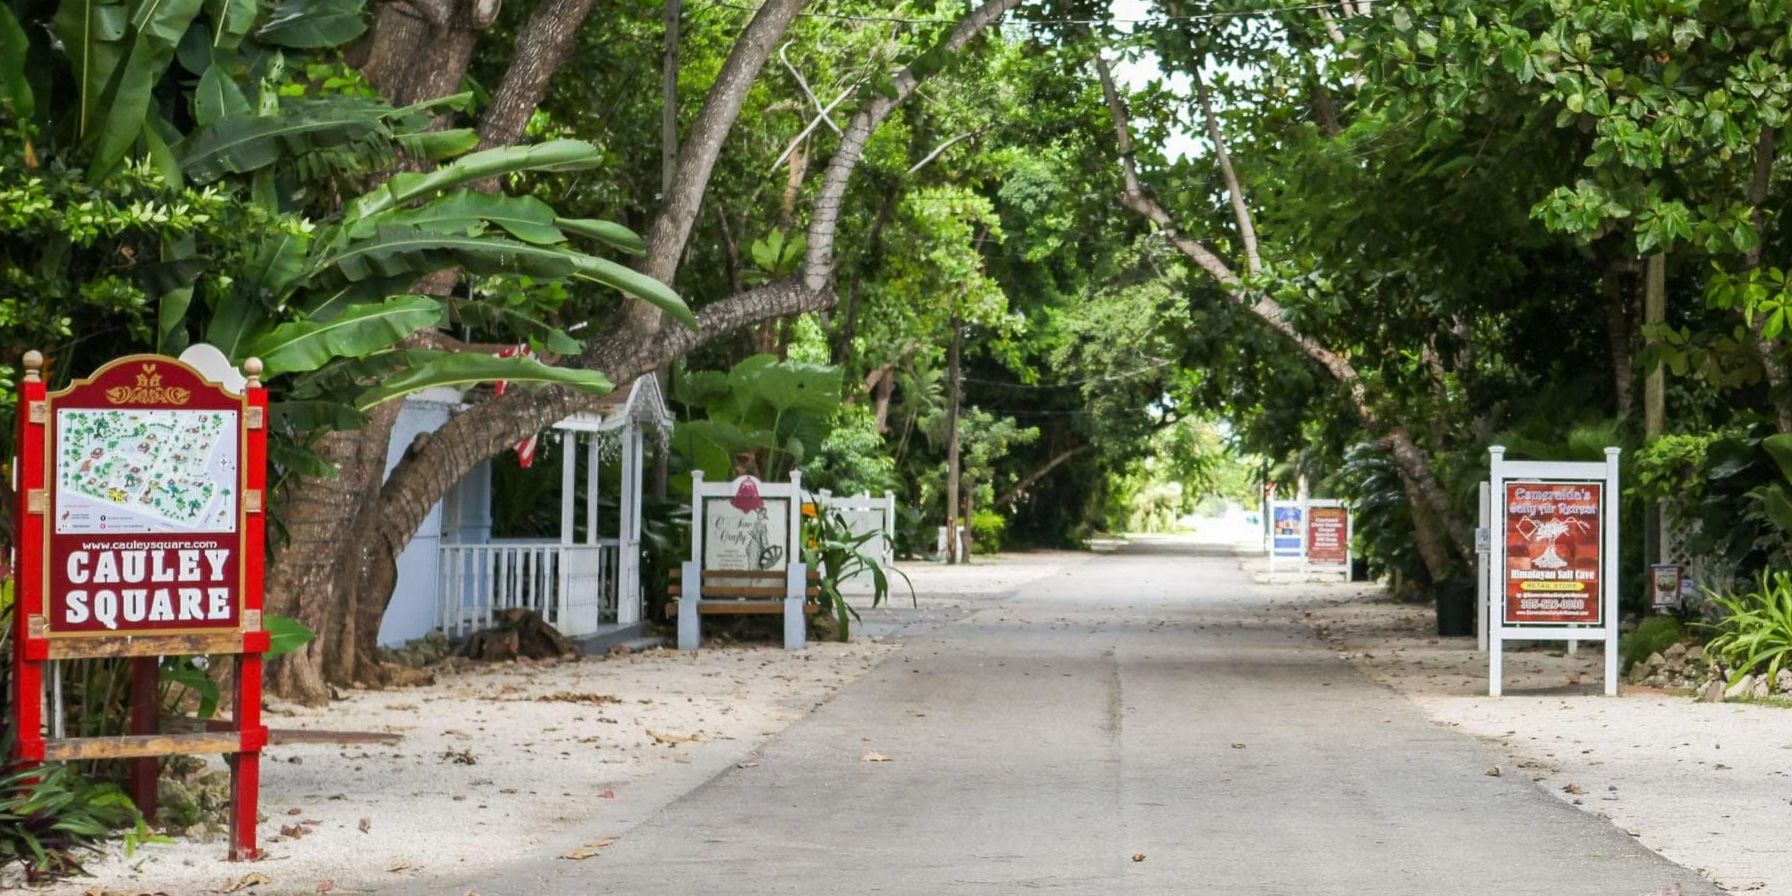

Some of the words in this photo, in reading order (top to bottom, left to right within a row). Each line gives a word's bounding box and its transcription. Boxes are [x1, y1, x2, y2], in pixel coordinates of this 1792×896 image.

[1515, 488, 1591, 501] Esmeralda's
[1558, 502, 1596, 515] Retreat
[716, 530, 747, 545] Crafty
[82, 540, 217, 551] www.cauleysquare.com
[66, 549, 230, 584] CAULEY
[1511, 570, 1556, 580] Himalayan
[1557, 570, 1573, 579] Salt
[1575, 570, 1595, 579] Cave
[66, 587, 231, 631] SQUARE
